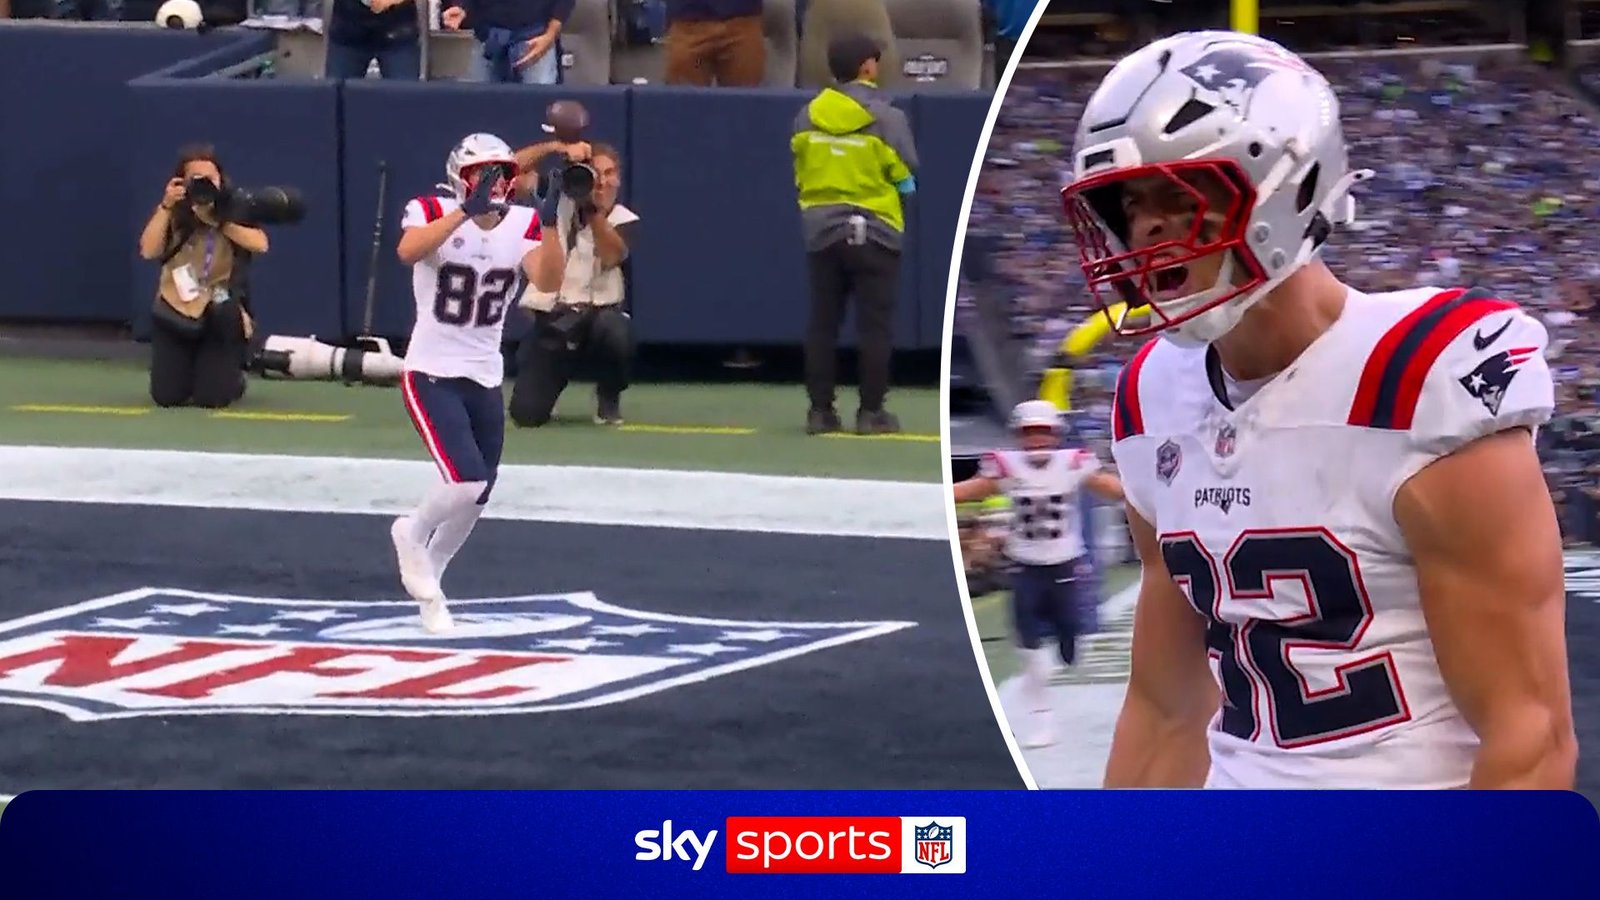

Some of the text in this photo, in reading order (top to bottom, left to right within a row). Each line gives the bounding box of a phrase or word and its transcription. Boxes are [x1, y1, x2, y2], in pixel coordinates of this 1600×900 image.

[434, 262, 516, 327] 82
[1195, 487, 1251, 508] PATRIOTS
[0, 635, 574, 699] NFL
